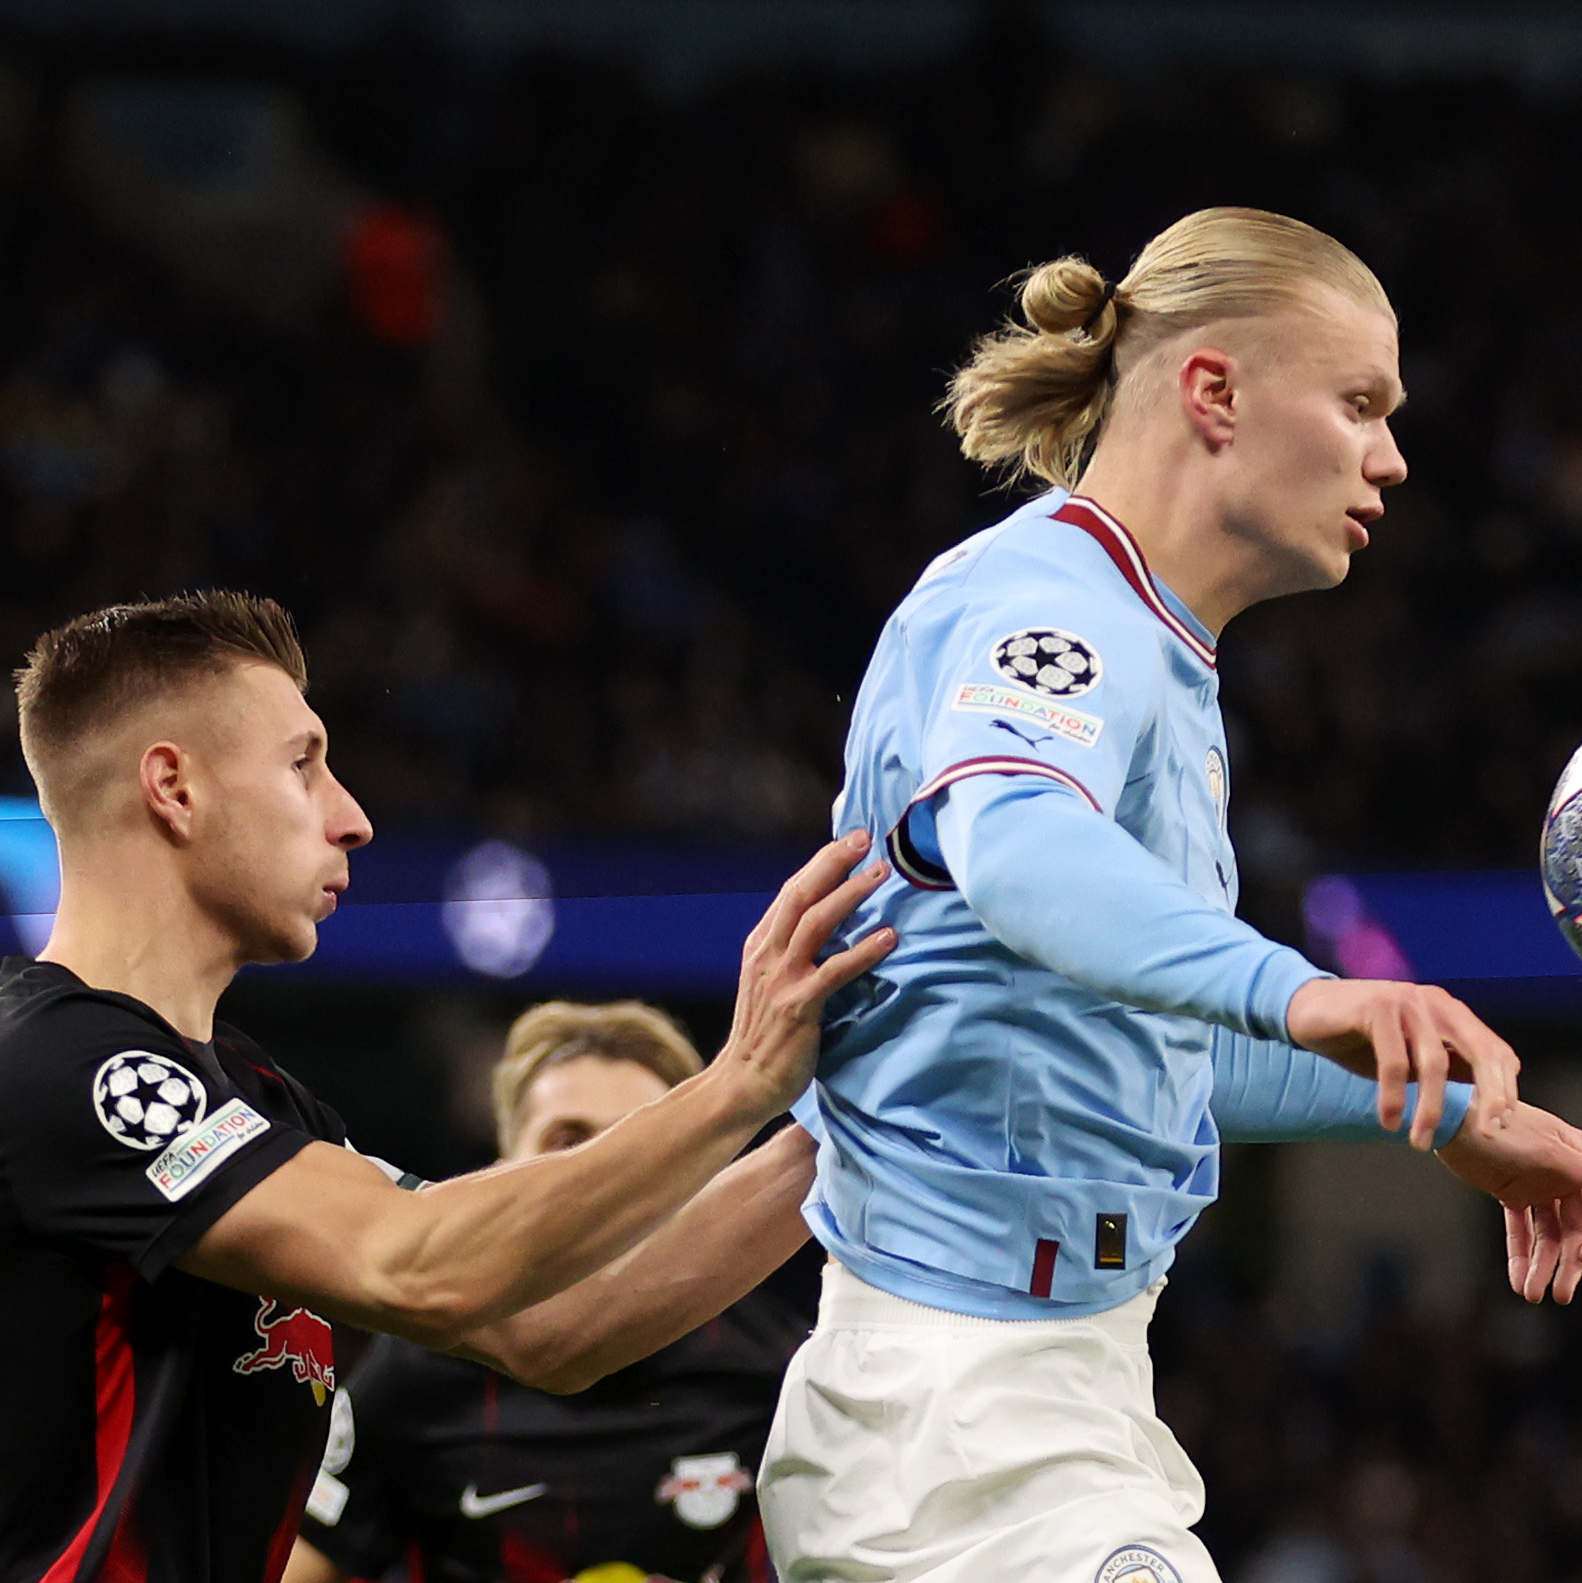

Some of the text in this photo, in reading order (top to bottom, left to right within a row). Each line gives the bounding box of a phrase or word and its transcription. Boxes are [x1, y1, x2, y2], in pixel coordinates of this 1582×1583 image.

[959, 691, 1097, 737] FOUNDATION
[152, 1151, 178, 1178] UEFA
[158, 1107, 257, 1189] FOUNDATION
